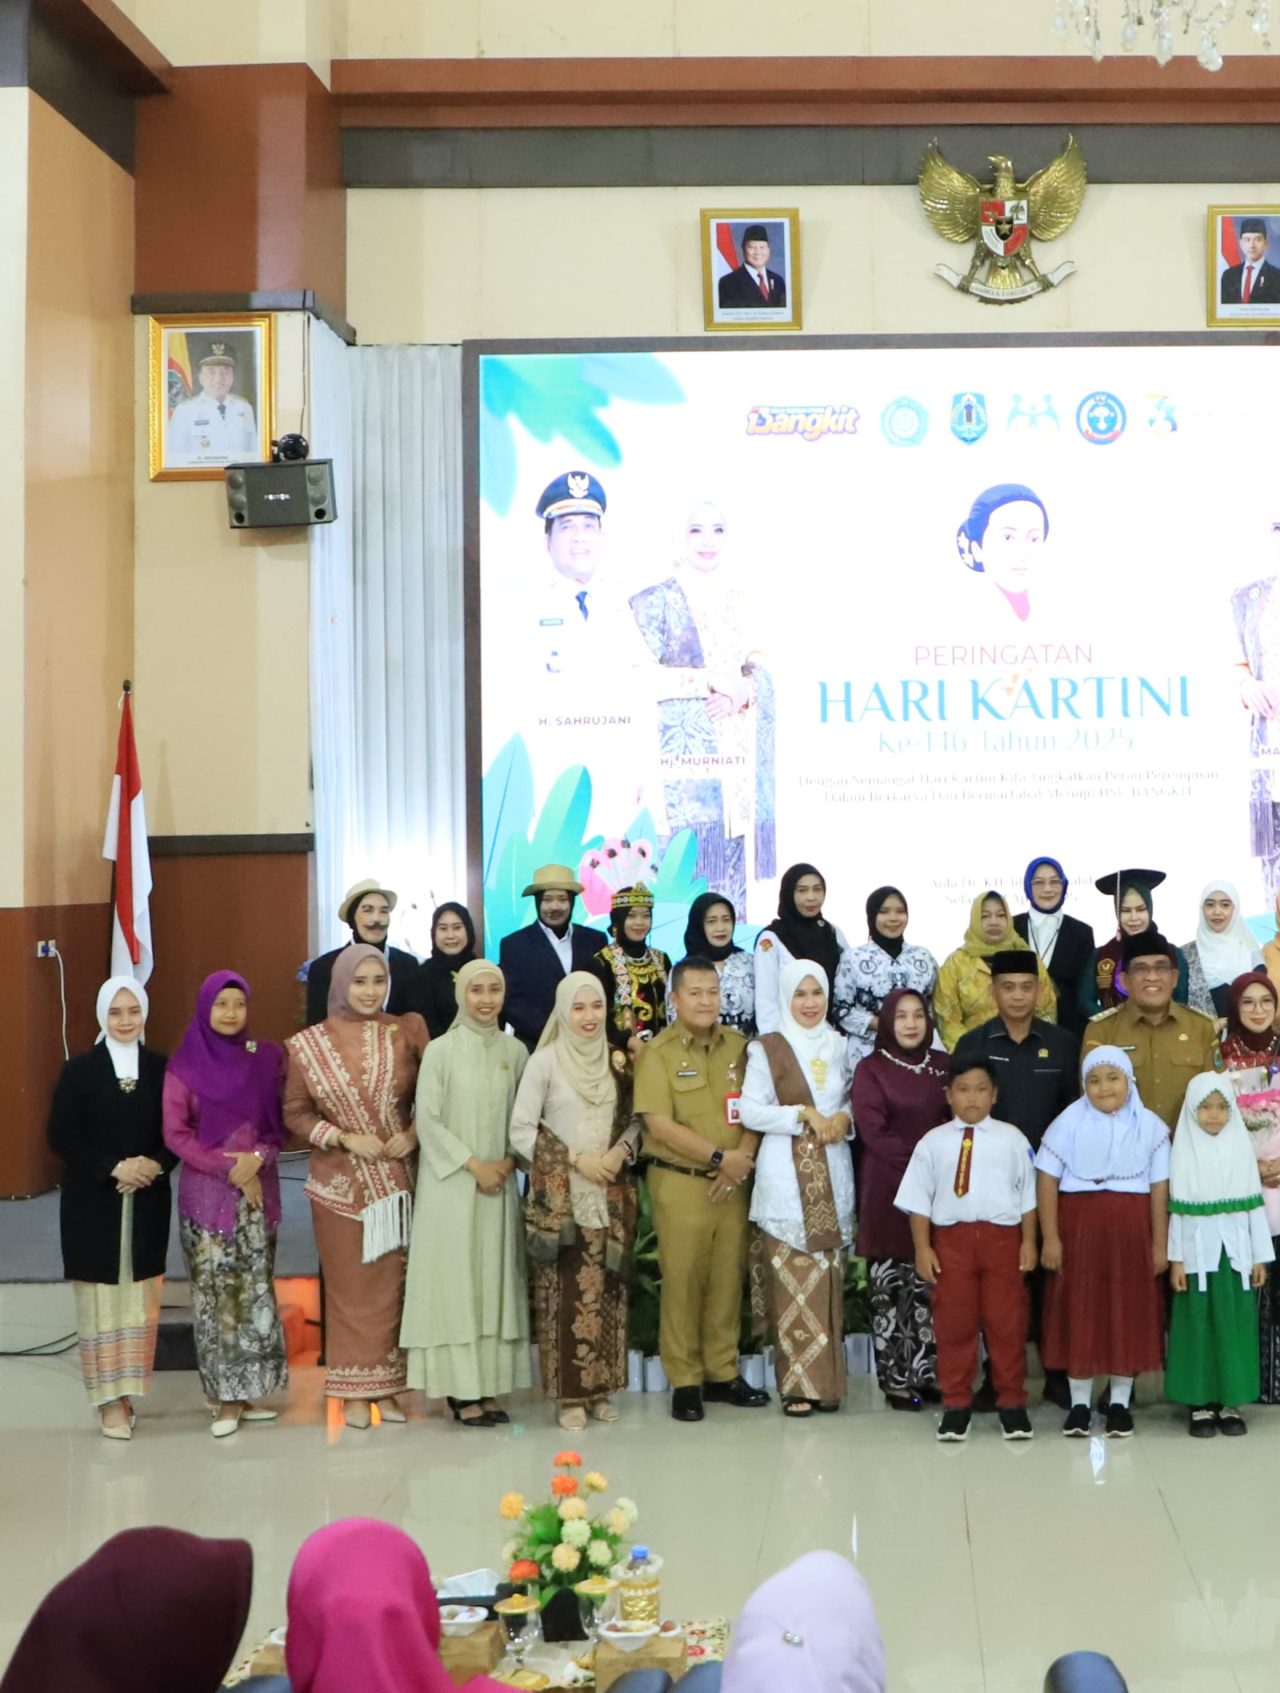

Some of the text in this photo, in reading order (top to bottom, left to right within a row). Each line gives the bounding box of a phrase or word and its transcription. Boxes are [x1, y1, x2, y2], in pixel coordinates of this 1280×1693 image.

[914, 643, 1094, 667] PERINGATAN
[816, 675, 1192, 724] HARI KARTINI
[538, 716, 632, 727] H. SAHRUJANI
[975, 729, 1057, 753] Tahun
[1066, 727, 1136, 752] 2025
[681, 756, 746, 767] MURNIATI
